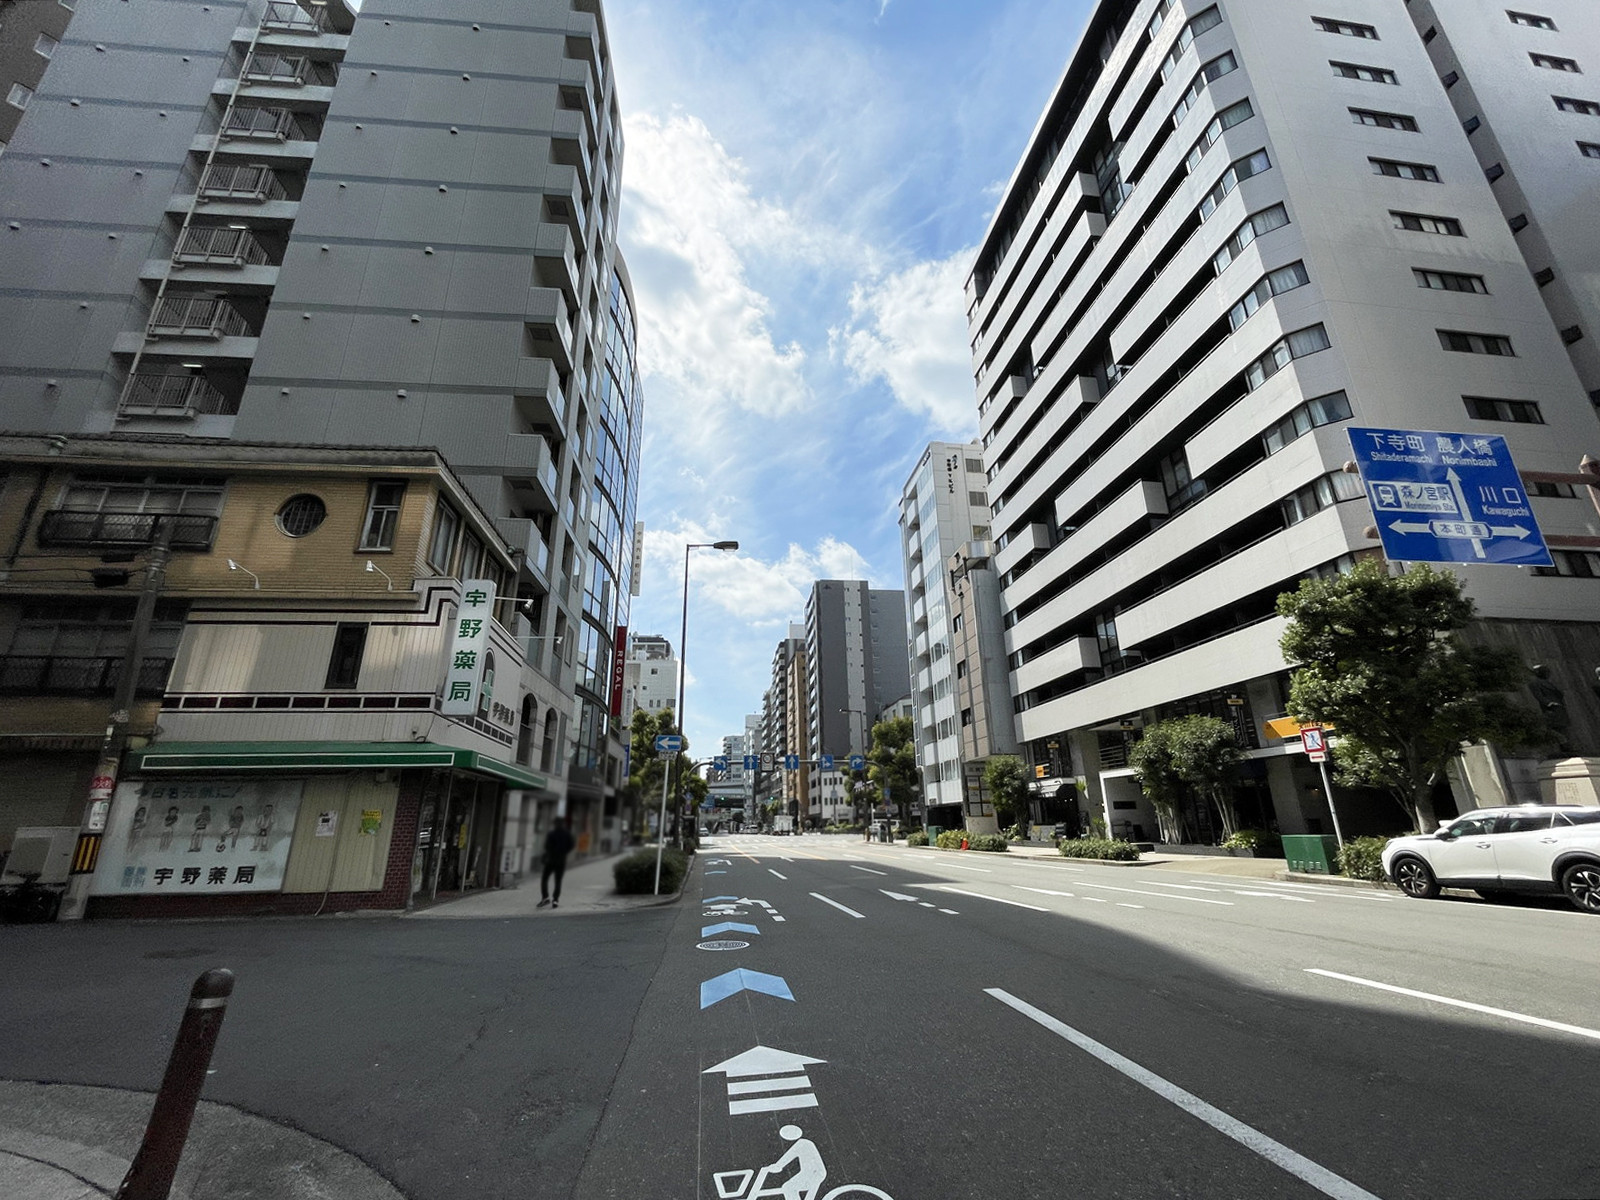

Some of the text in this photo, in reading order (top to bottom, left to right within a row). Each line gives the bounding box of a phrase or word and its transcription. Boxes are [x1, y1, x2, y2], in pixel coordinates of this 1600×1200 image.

[1366, 433, 1493, 456] 下寺町 農人橋
[1370, 451, 1433, 464] Shitaderamachi
[1401, 485, 1452, 501] 森ノ宮駅
[1479, 486, 1522, 504] 川口
[1482, 505, 1530, 517] Kawaguchi
[1439, 523, 1483, 536] 本町通
[448, 589, 487, 701] 宇野薬局
[614, 650, 624, 691] REGAL
[153, 866, 256, 885] 宇野薬局
